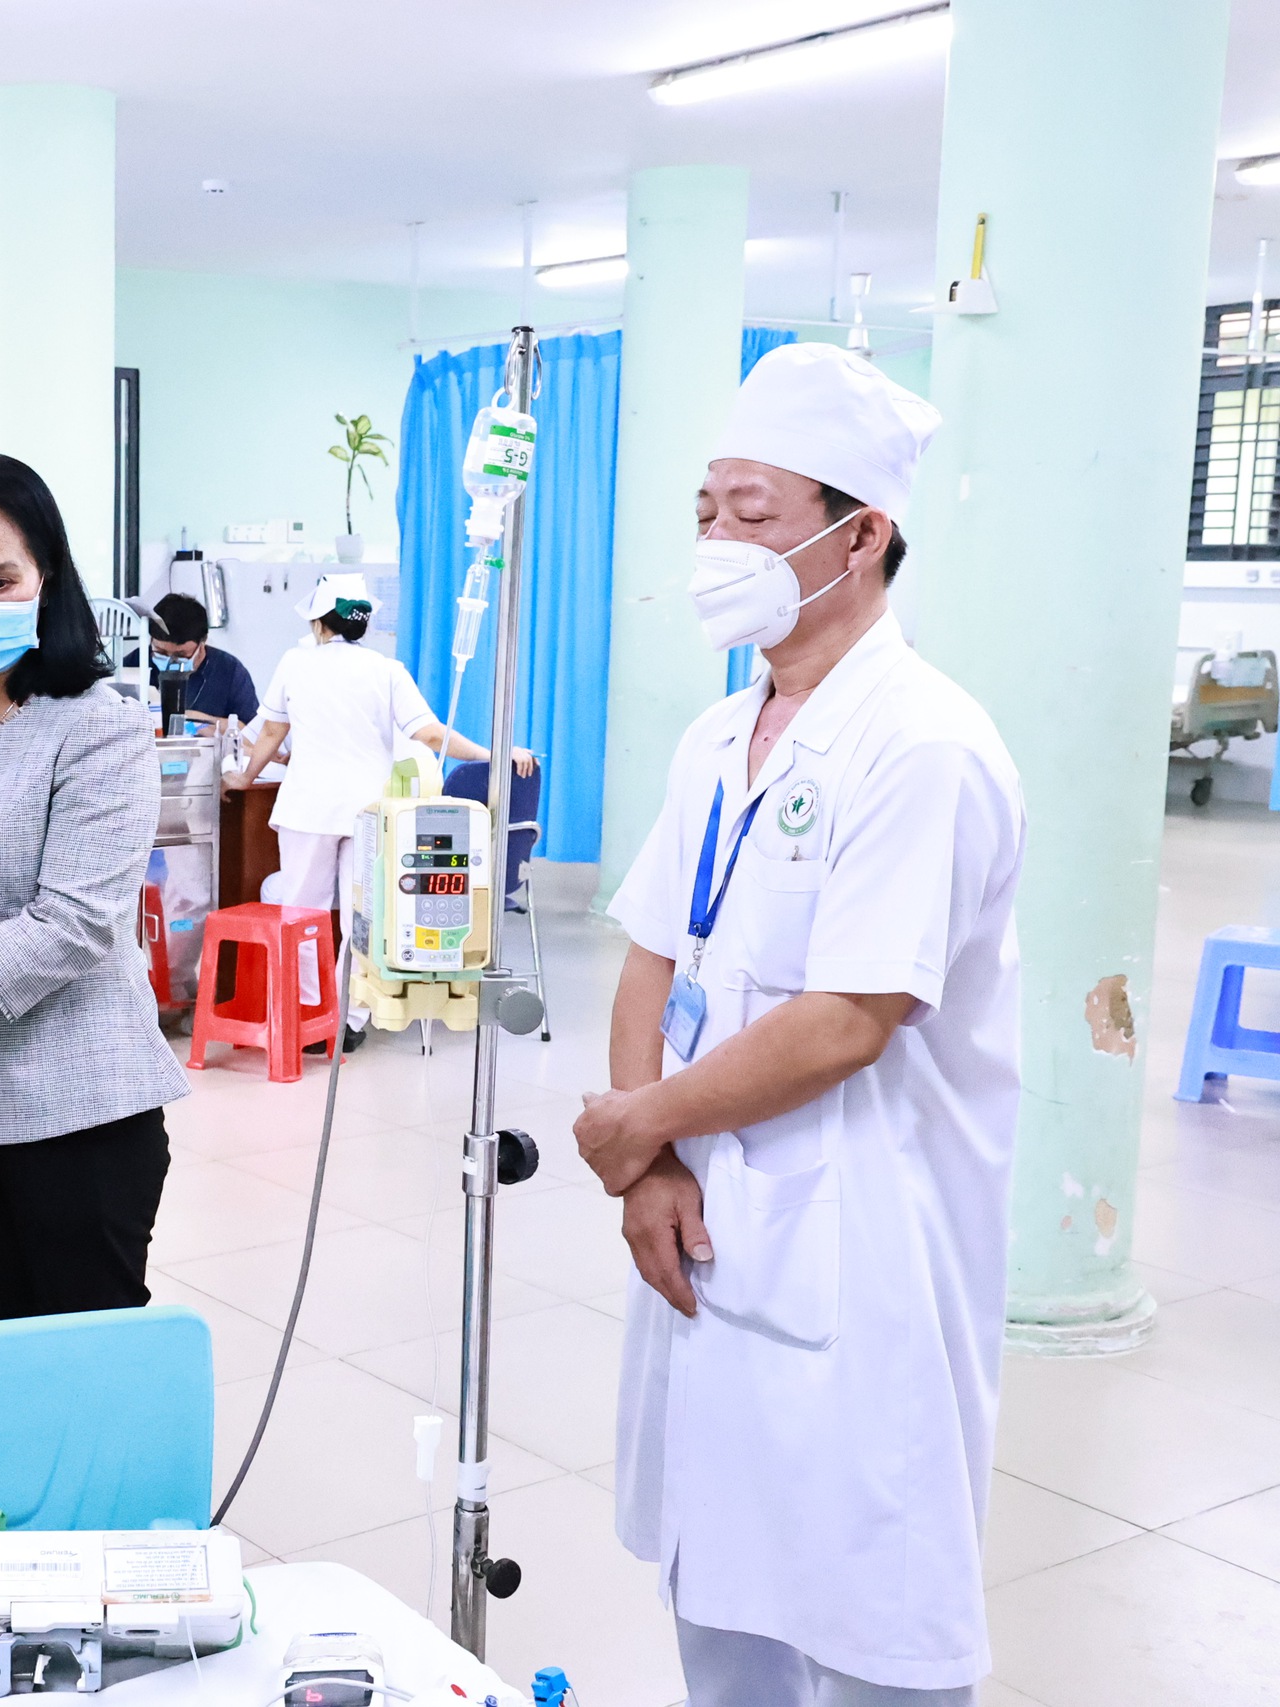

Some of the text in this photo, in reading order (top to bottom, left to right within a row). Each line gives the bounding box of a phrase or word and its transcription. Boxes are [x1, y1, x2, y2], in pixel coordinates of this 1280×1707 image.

[503, 448, 528, 467] G-5
[428, 874, 464, 894] 100
[133, 1593, 171, 1601] TERUMO
